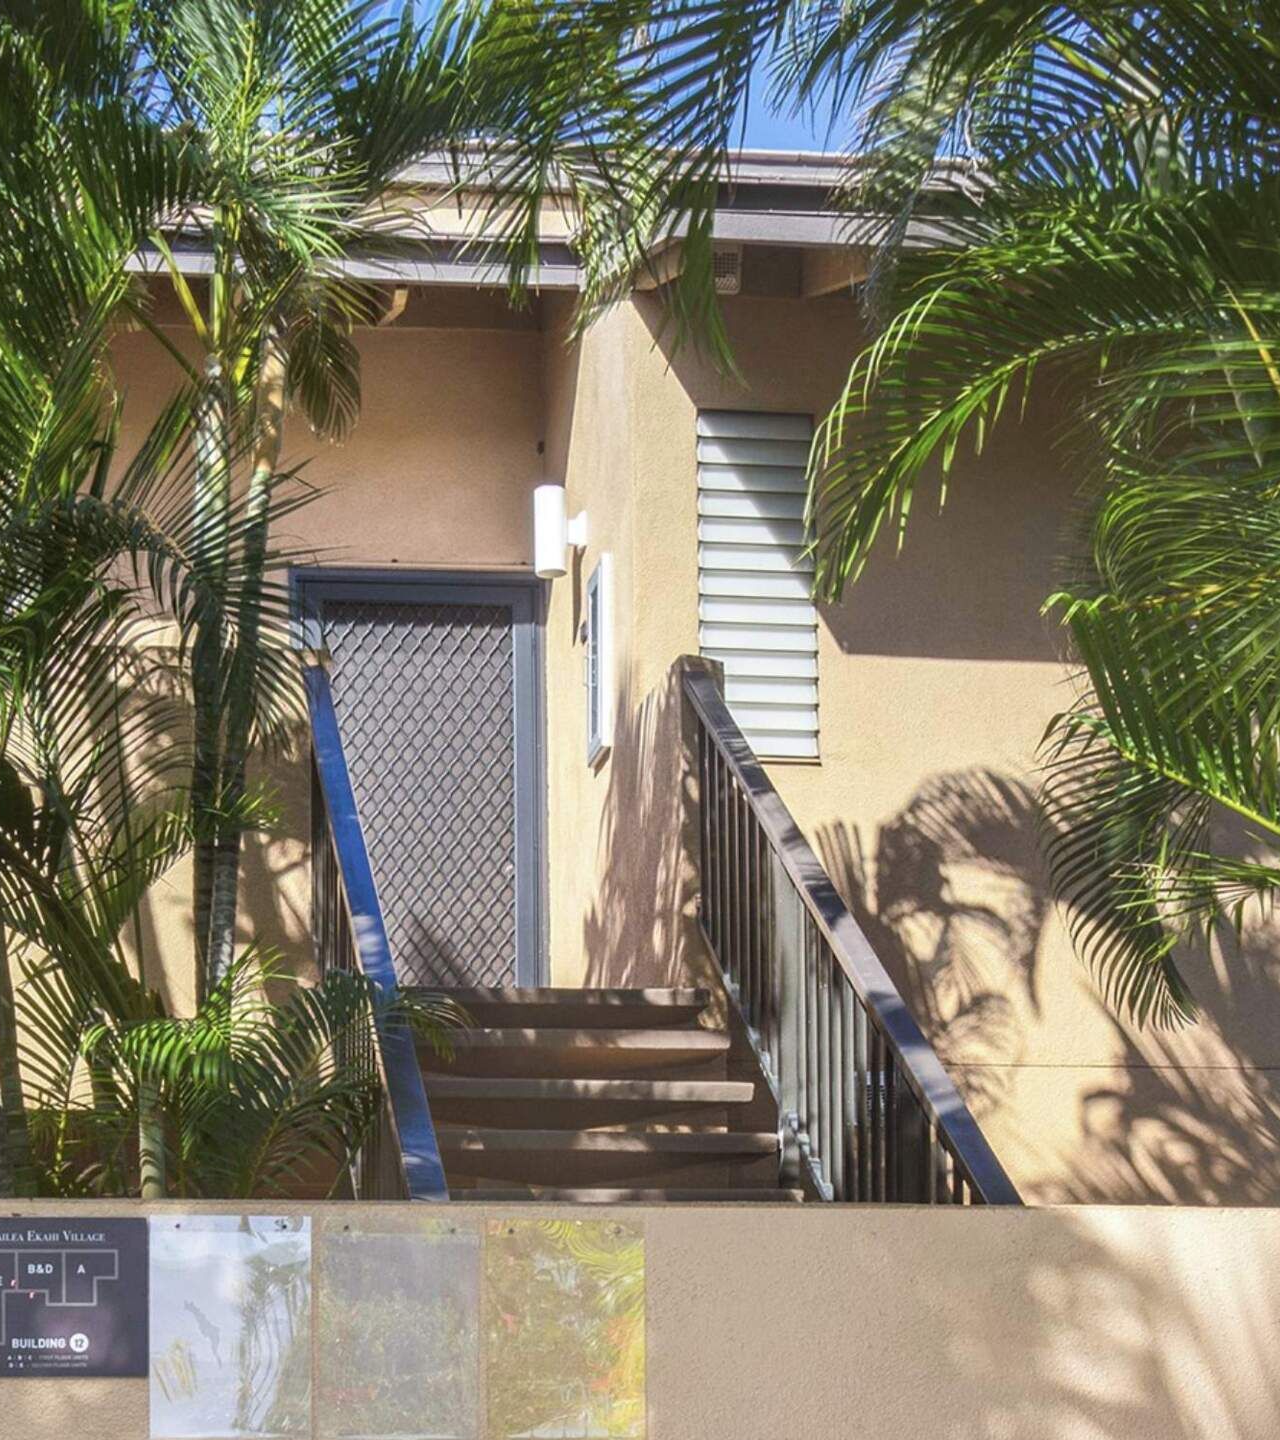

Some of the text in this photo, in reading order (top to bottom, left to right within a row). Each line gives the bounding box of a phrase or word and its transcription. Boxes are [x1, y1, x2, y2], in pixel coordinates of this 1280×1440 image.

[63, 1230, 106, 1241] VILLAGE
[27, 1264, 53, 1274] B&D
[76, 1264, 86, 1274] A
[11, 1338, 66, 1349] BUILDING
